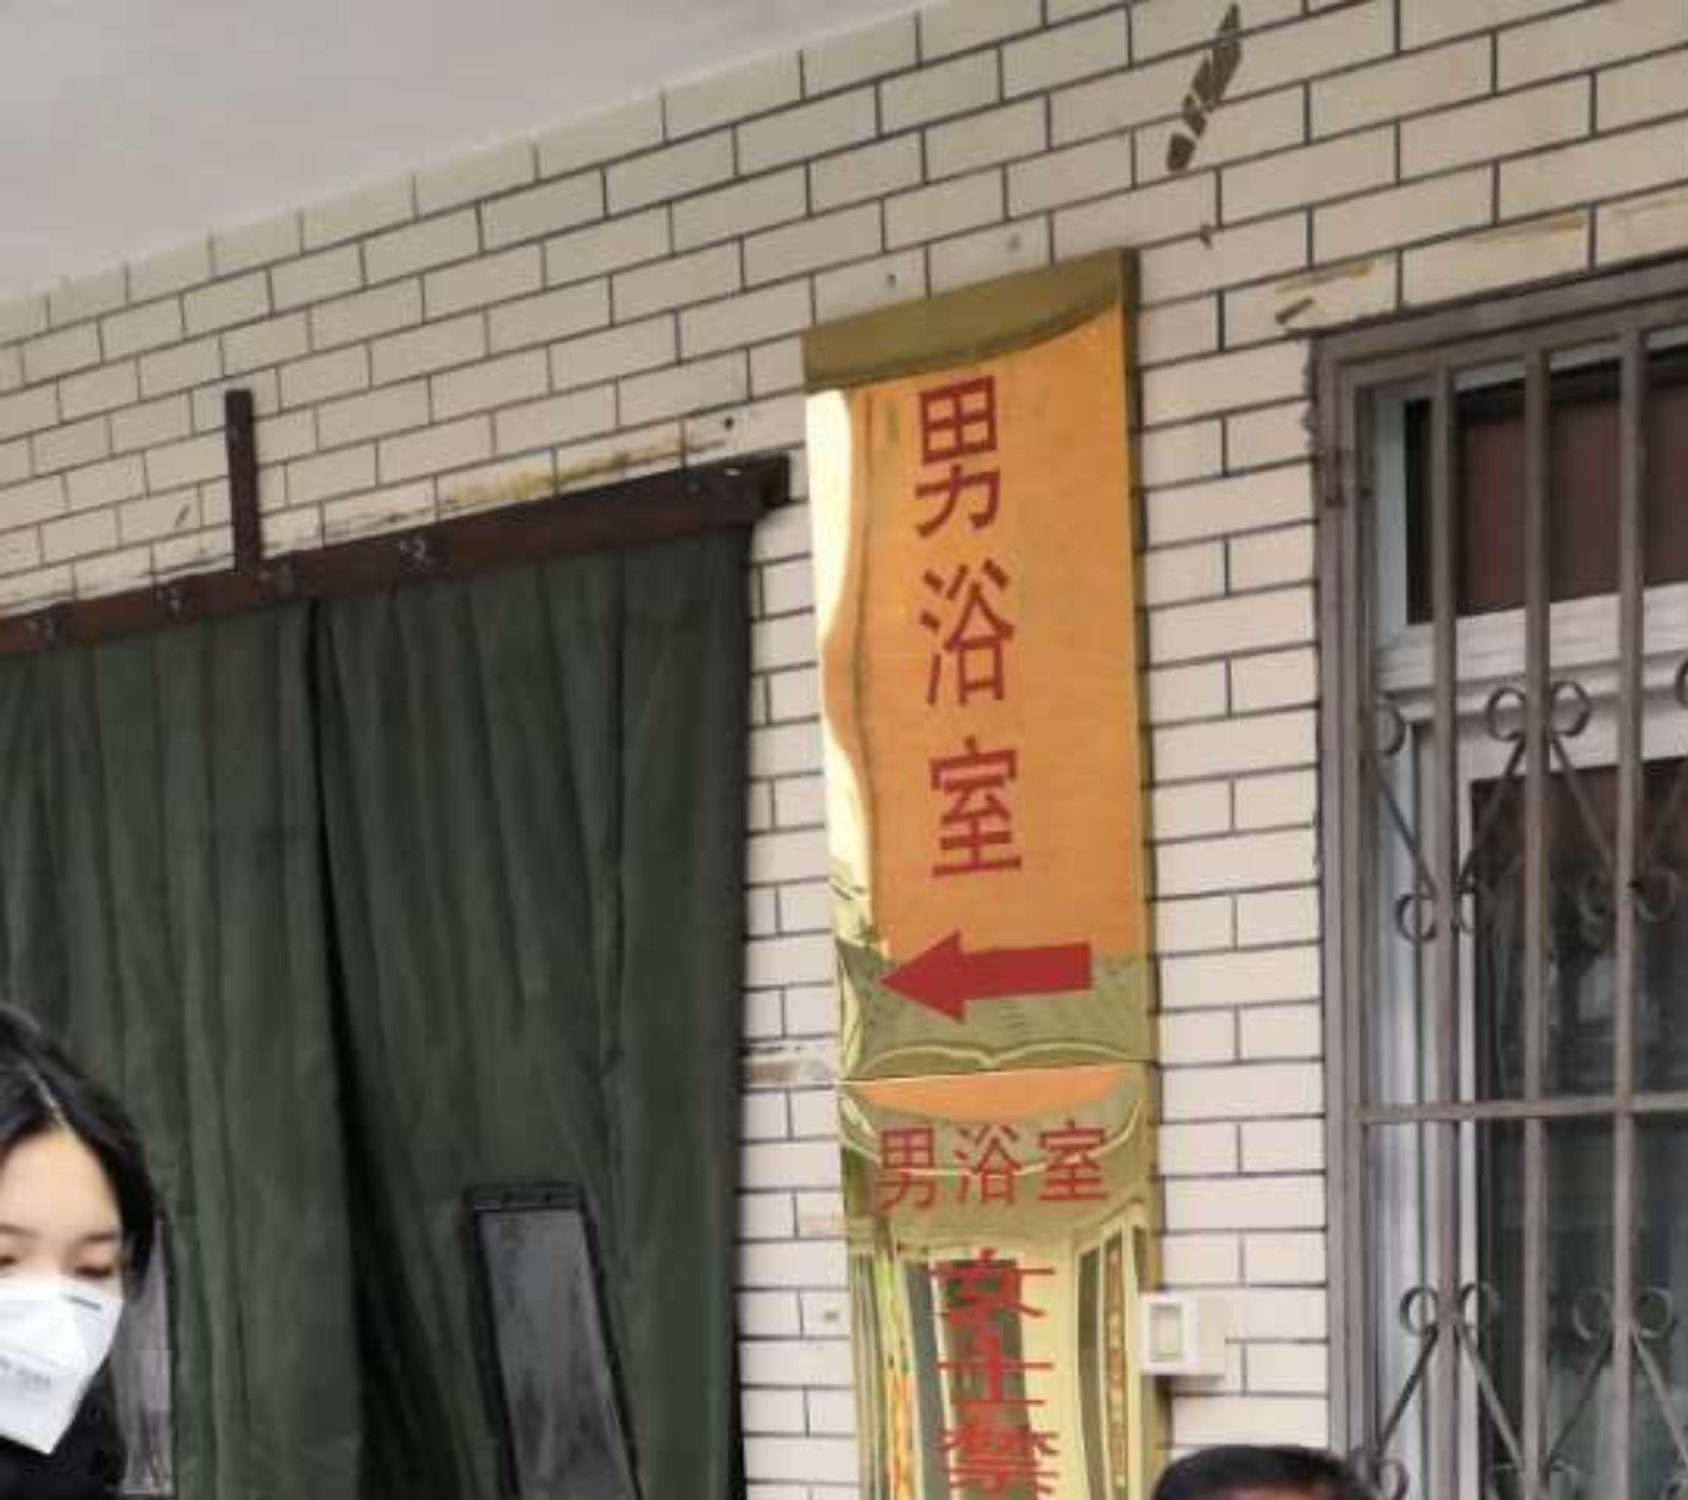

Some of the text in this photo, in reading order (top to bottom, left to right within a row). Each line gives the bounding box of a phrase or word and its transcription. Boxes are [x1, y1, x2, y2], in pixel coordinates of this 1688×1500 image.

[914, 374, 1023, 879] 男浴室
[875, 1119, 1110, 1212] 男浴室
